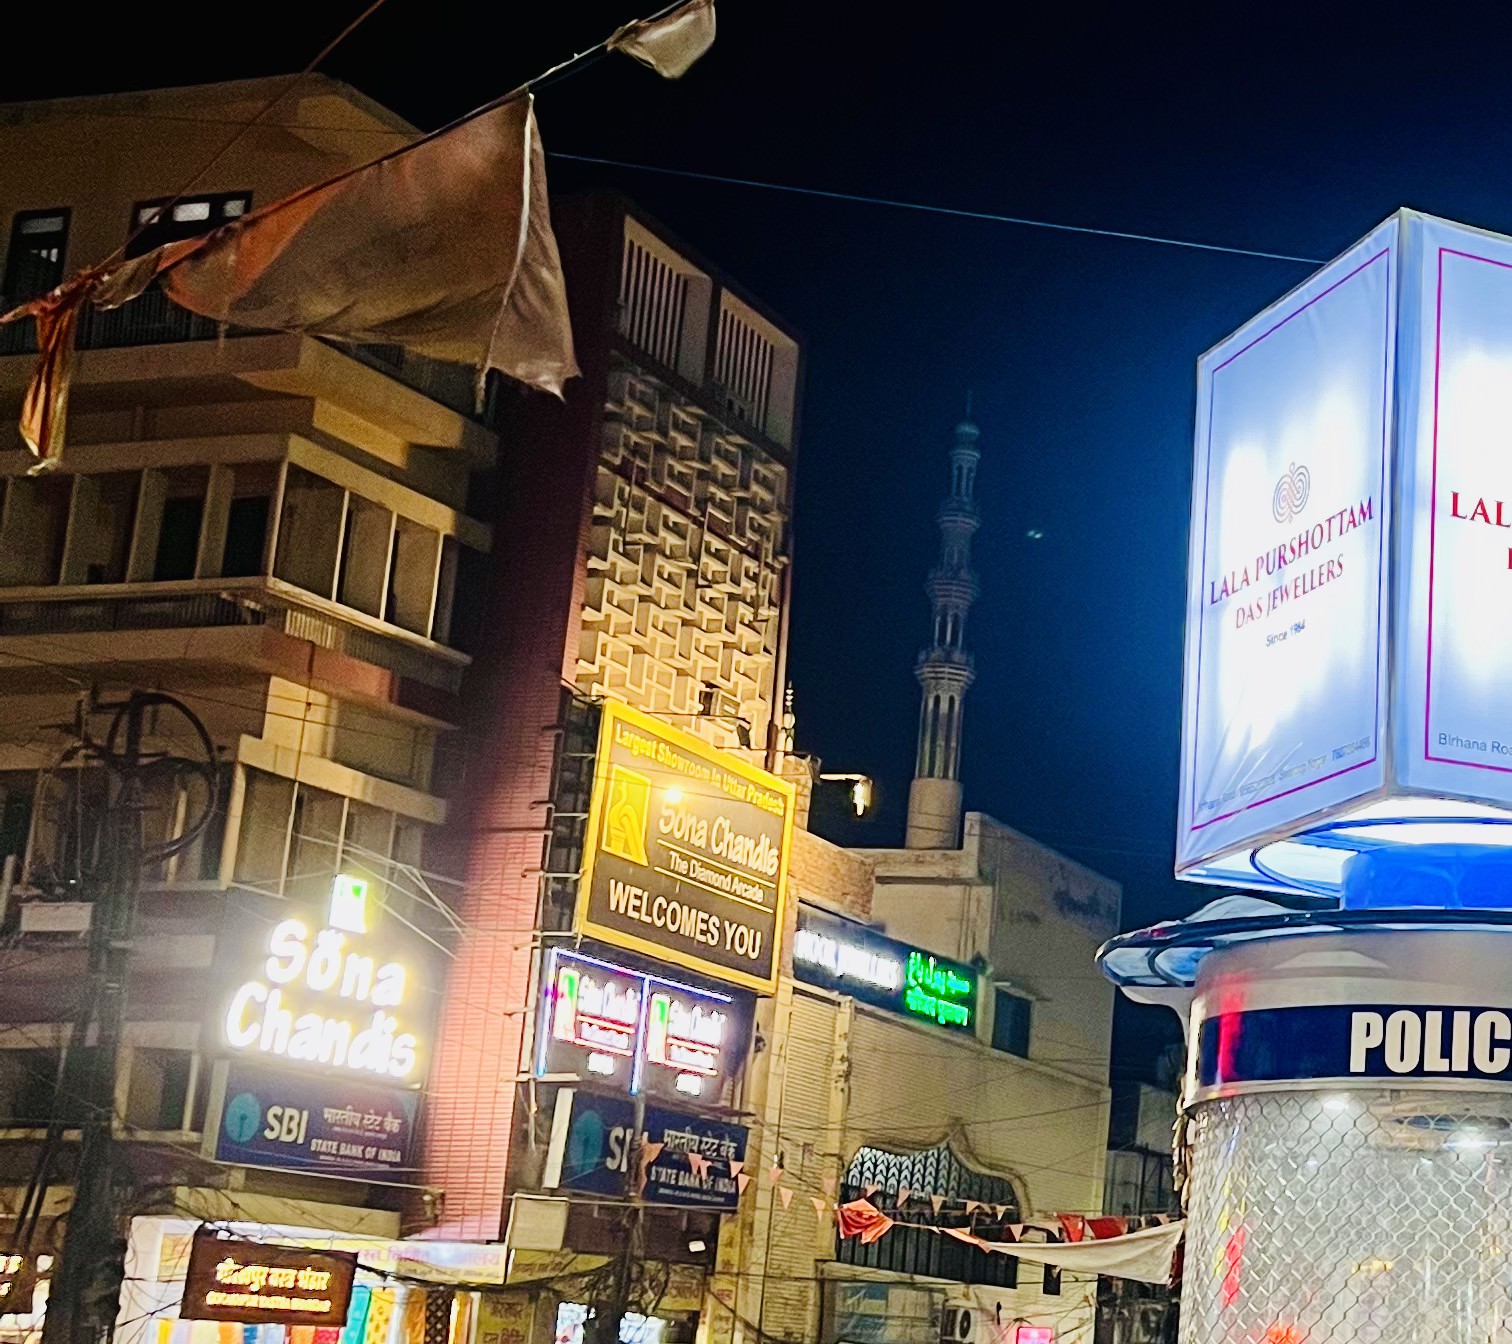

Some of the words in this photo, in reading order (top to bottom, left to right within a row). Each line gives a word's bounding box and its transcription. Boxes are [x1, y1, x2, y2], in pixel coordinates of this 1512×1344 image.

[1210, 565, 1251, 605] LALA
[1255, 496, 1374, 581] PURSHOTTAM
[1236, 596, 1262, 629] DAS
[1267, 553, 1344, 616] JEWELLERS
[1266, 631, 1288, 647] Since
[1438, 732, 1487, 752] Birhana
[615, 723, 656, 759] Largest
[656, 742, 711, 782] Showroom
[722, 773, 747, 801] Uttar
[669, 851, 690, 875] The
[689, 859, 734, 892] Diamond
[732, 877, 764, 904] Arcade
[609, 879, 720, 947] WELCOMES
[723, 920, 762, 960] YOU
[264, 1105, 309, 1145] SBI
[323, 1104, 362, 1127] भारतीय
[310, 1138, 339, 1154] STATE
[339, 1143, 364, 1158] BANK
[364, 1146, 378, 1159] OF
[377, 1148, 401, 1162] INDIA
[664, 1126, 700, 1153] भारतीय
[650, 1166, 678, 1185] STATE
